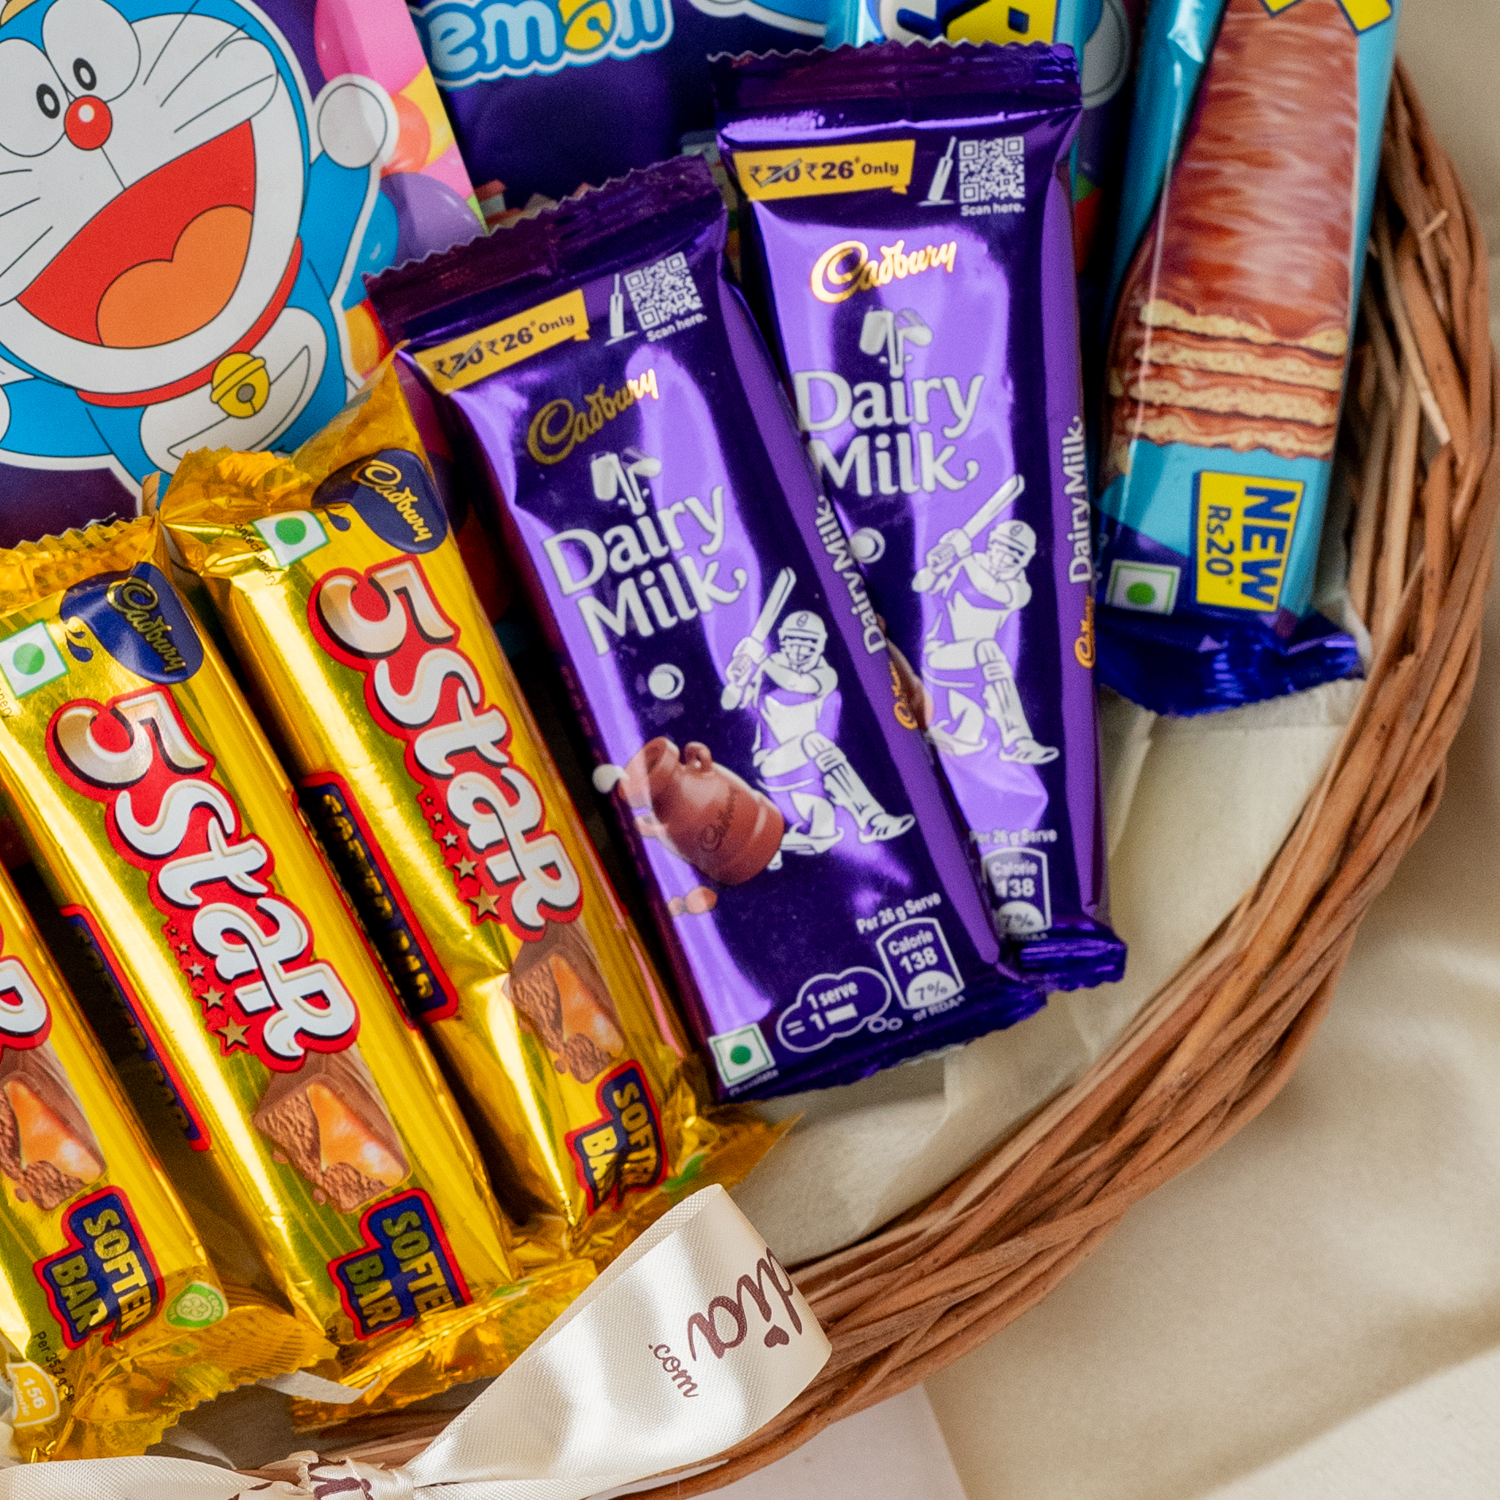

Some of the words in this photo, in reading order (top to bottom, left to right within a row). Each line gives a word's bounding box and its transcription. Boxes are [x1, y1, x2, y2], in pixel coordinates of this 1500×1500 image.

[861, 161, 899, 179] Only
[961, 203, 990, 217] Scan
[810, 240, 958, 304] Cadbury
[538, 313, 576, 335] Only
[647, 324, 675, 343] Scan
[527, 367, 661, 465] Cadbury
[794, 370, 985, 439] Dairy
[811, 430, 980, 499] Milk
[352, 459, 433, 544] Cadbury
[543, 486, 725, 597] Dairy
[1066, 497, 1093, 584] Dairy
[1239, 485, 1297, 606] NEW
[107, 577, 189, 674] Cadbury
[576, 554, 748, 656] Milk
[842, 571, 887, 655] Dairy
[855, 916, 879, 935] Per
[904, 891, 942, 916] Serve
[995, 877, 1036, 899] 138
[887, 929, 935, 956] Calorie
[898, 946, 939, 974] 138
[818, 981, 859, 1006] serve
[913, 980, 948, 1000] 7%
[50, 1256, 108, 1333] BAR
[85, 1208, 153, 1330] SOFTER
[346, 1254, 402, 1328] BAR
[34, 1330, 51, 1353] Per
[45, 1352, 66, 1378] 35.2
[22, 1377, 47, 1410] 156
[55, 1378, 67, 1388] g
[648, 1344, 700, 1398] .com
